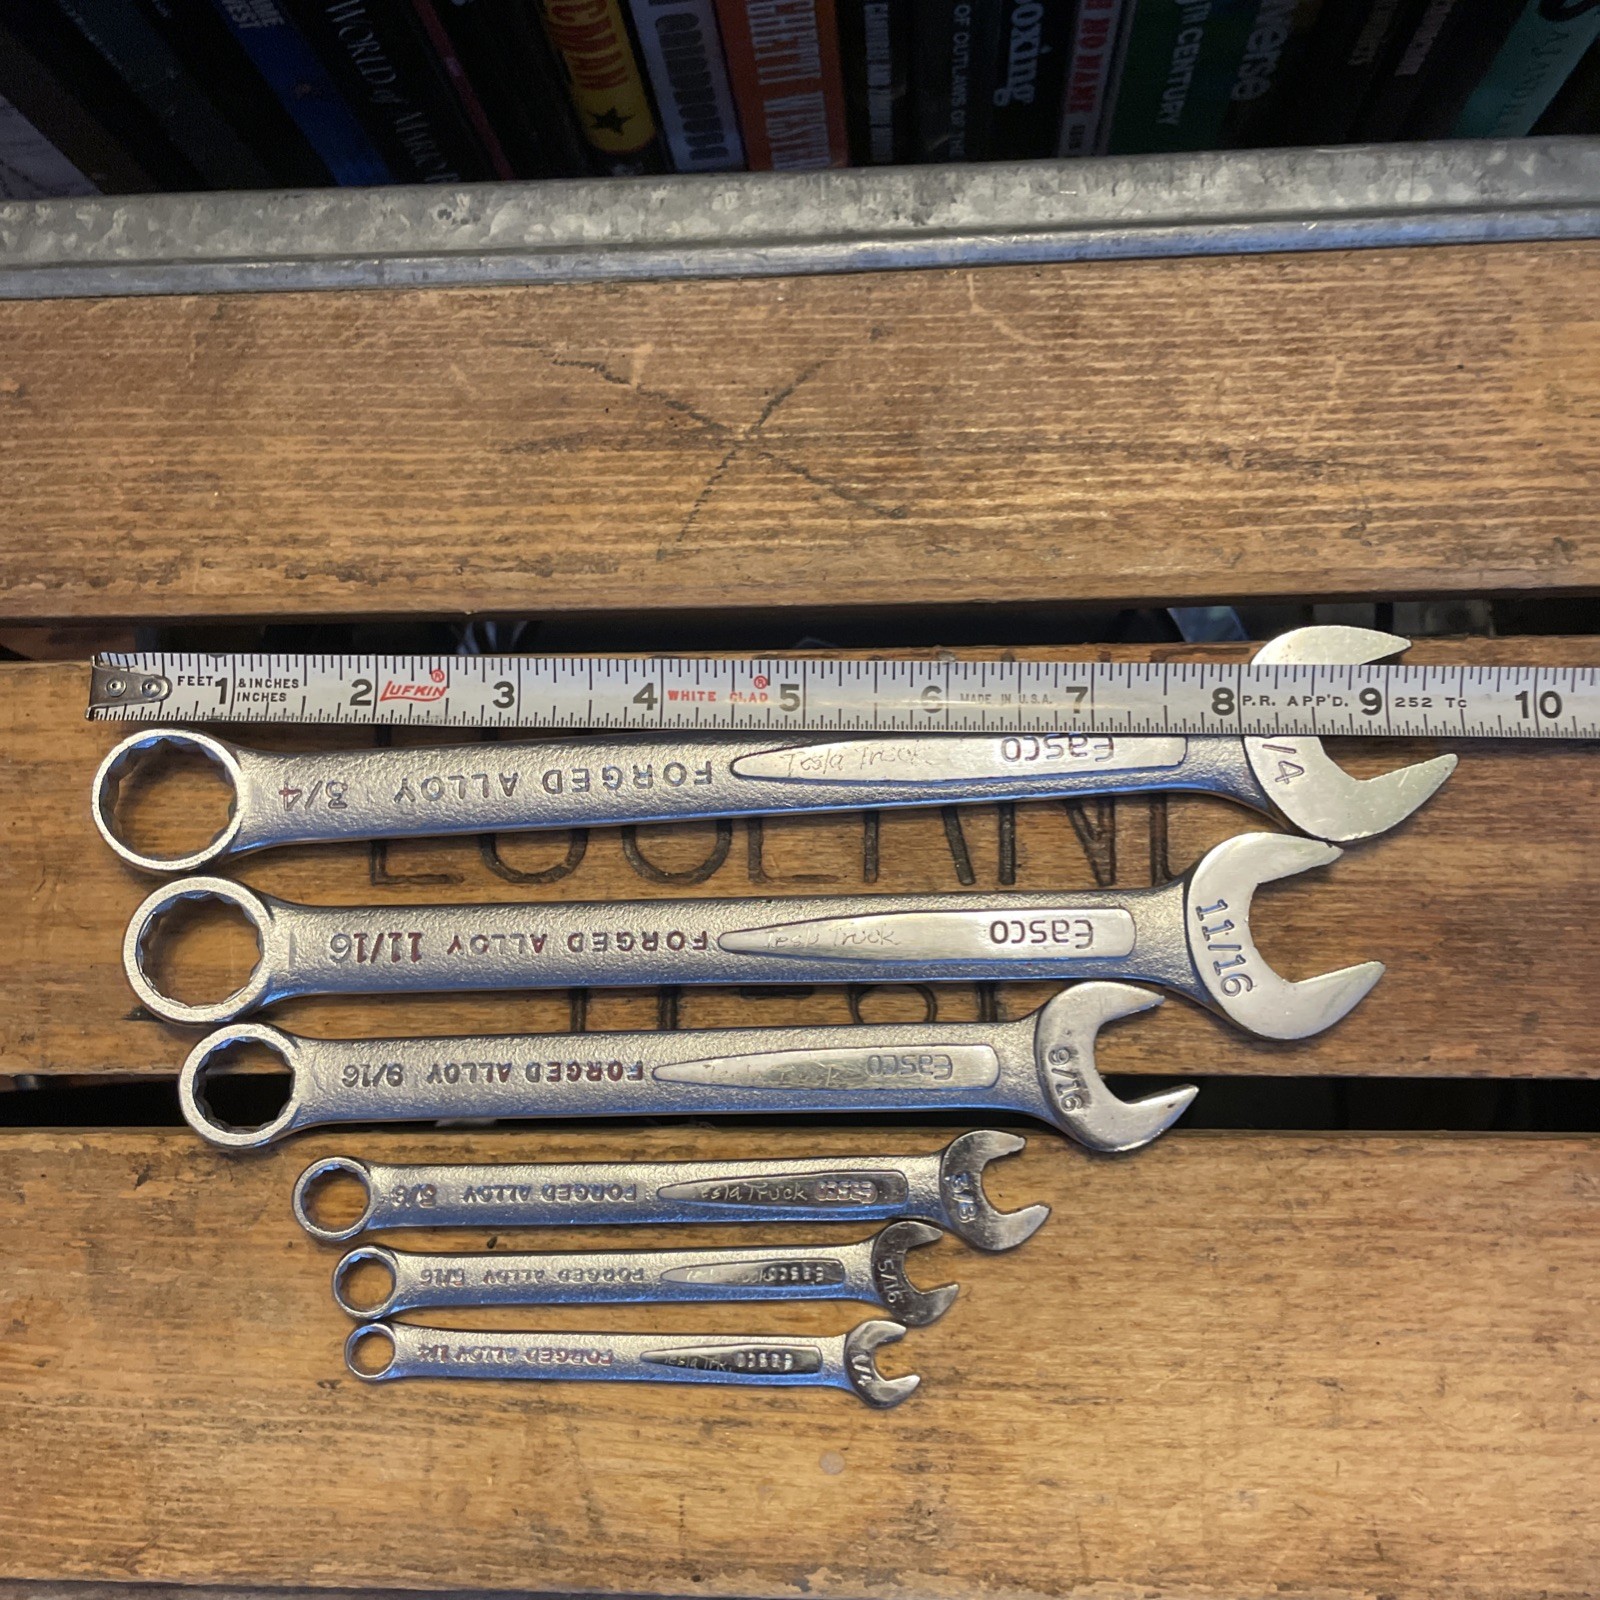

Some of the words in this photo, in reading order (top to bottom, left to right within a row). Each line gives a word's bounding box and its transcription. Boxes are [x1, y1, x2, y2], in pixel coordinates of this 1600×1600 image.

[952, 3, 971, 27] OF
[992, 0, 1054, 107] oxing
[950, 31, 971, 107] OUTLAWS
[1155, 26, 1205, 125] CENTURY
[177, 675, 214, 687] FEET
[214, 677, 228, 705] 1
[349, 678, 372, 706] 2
[492, 681, 515, 709] 3
[236, 692, 287, 702] INCHES
[632, 682, 658, 711] 4
[668, 690, 716, 702] WHITE
[729, 691, 768, 703] CLAD
[780, 683, 800, 712] 5
[920, 685, 943, 714] 6
[960, 693, 992, 705] MADE
[1000, 693, 1012, 705] IN
[1018, 693, 1053, 705] U.S.A.
[1065, 686, 1089, 714] 7
[1212, 687, 1235, 716] 8
[1242, 694, 1276, 707] P.R.
[1359, 687, 1382, 716] 9
[1395, 697, 1433, 708] 252
[1515, 690, 1563, 719] 10
[542, 761, 712, 795] FORGED
[1261, 743, 1305, 785] /4
[278, 780, 348, 811] 3/4
[394, 771, 519, 804] ALLOY
[330, 932, 422, 964] 11/16
[447, 933, 548, 956] ALLOY
[567, 930, 708, 953] FORGED
[1195, 899, 1254, 997] 11/16
[342, 1062, 405, 1087] 9/16
[427, 1061, 513, 1084] ALLOY
[525, 1060, 644, 1083] FORGED
[1047, 1046, 1084, 1112] 9/16
[463, 1184, 532, 1204] ALLOY
[541, 1183, 638, 1204] FORGED
[697, 1182, 743, 1201] esla
[743, 1181, 808, 1201] Truck
[483, 1269, 546, 1285] ALLOY
[558, 1267, 645, 1284] FORGED
[877, 1259, 900, 1303] 5/16
[522, 1347, 615, 1366] FORGED
